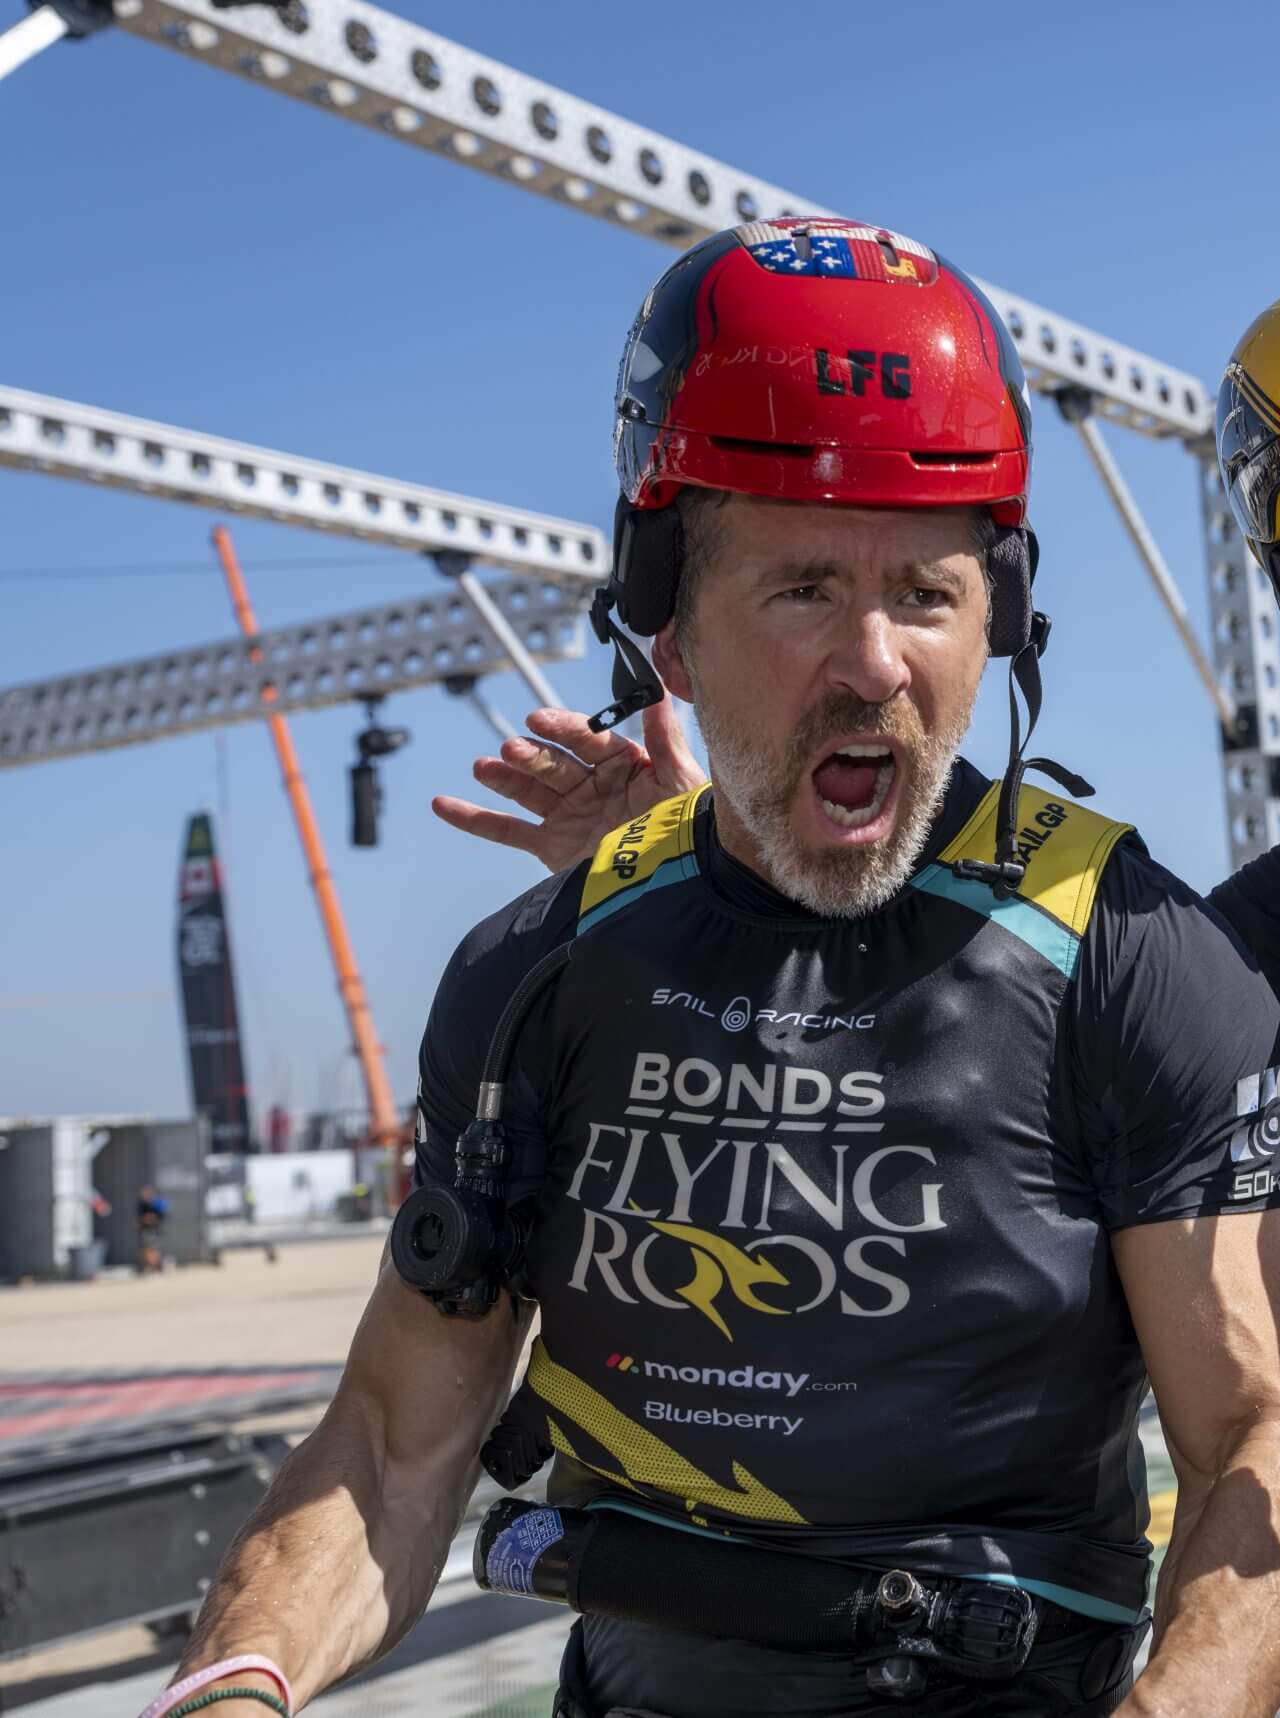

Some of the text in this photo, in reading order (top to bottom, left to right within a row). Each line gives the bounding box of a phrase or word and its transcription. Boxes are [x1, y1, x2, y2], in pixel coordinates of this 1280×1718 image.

[814, 348, 912, 400] LFG
[1017, 802, 1068, 868] AILGP
[651, 988, 877, 1029] SAIL RACING
[629, 1052, 886, 1117] BONDS
[566, 1121, 948, 1233] FLYING
[567, 1207, 911, 1318] ROOS
[644, 1359, 857, 1397] monday.com
[643, 1400, 804, 1436] Blueberry
